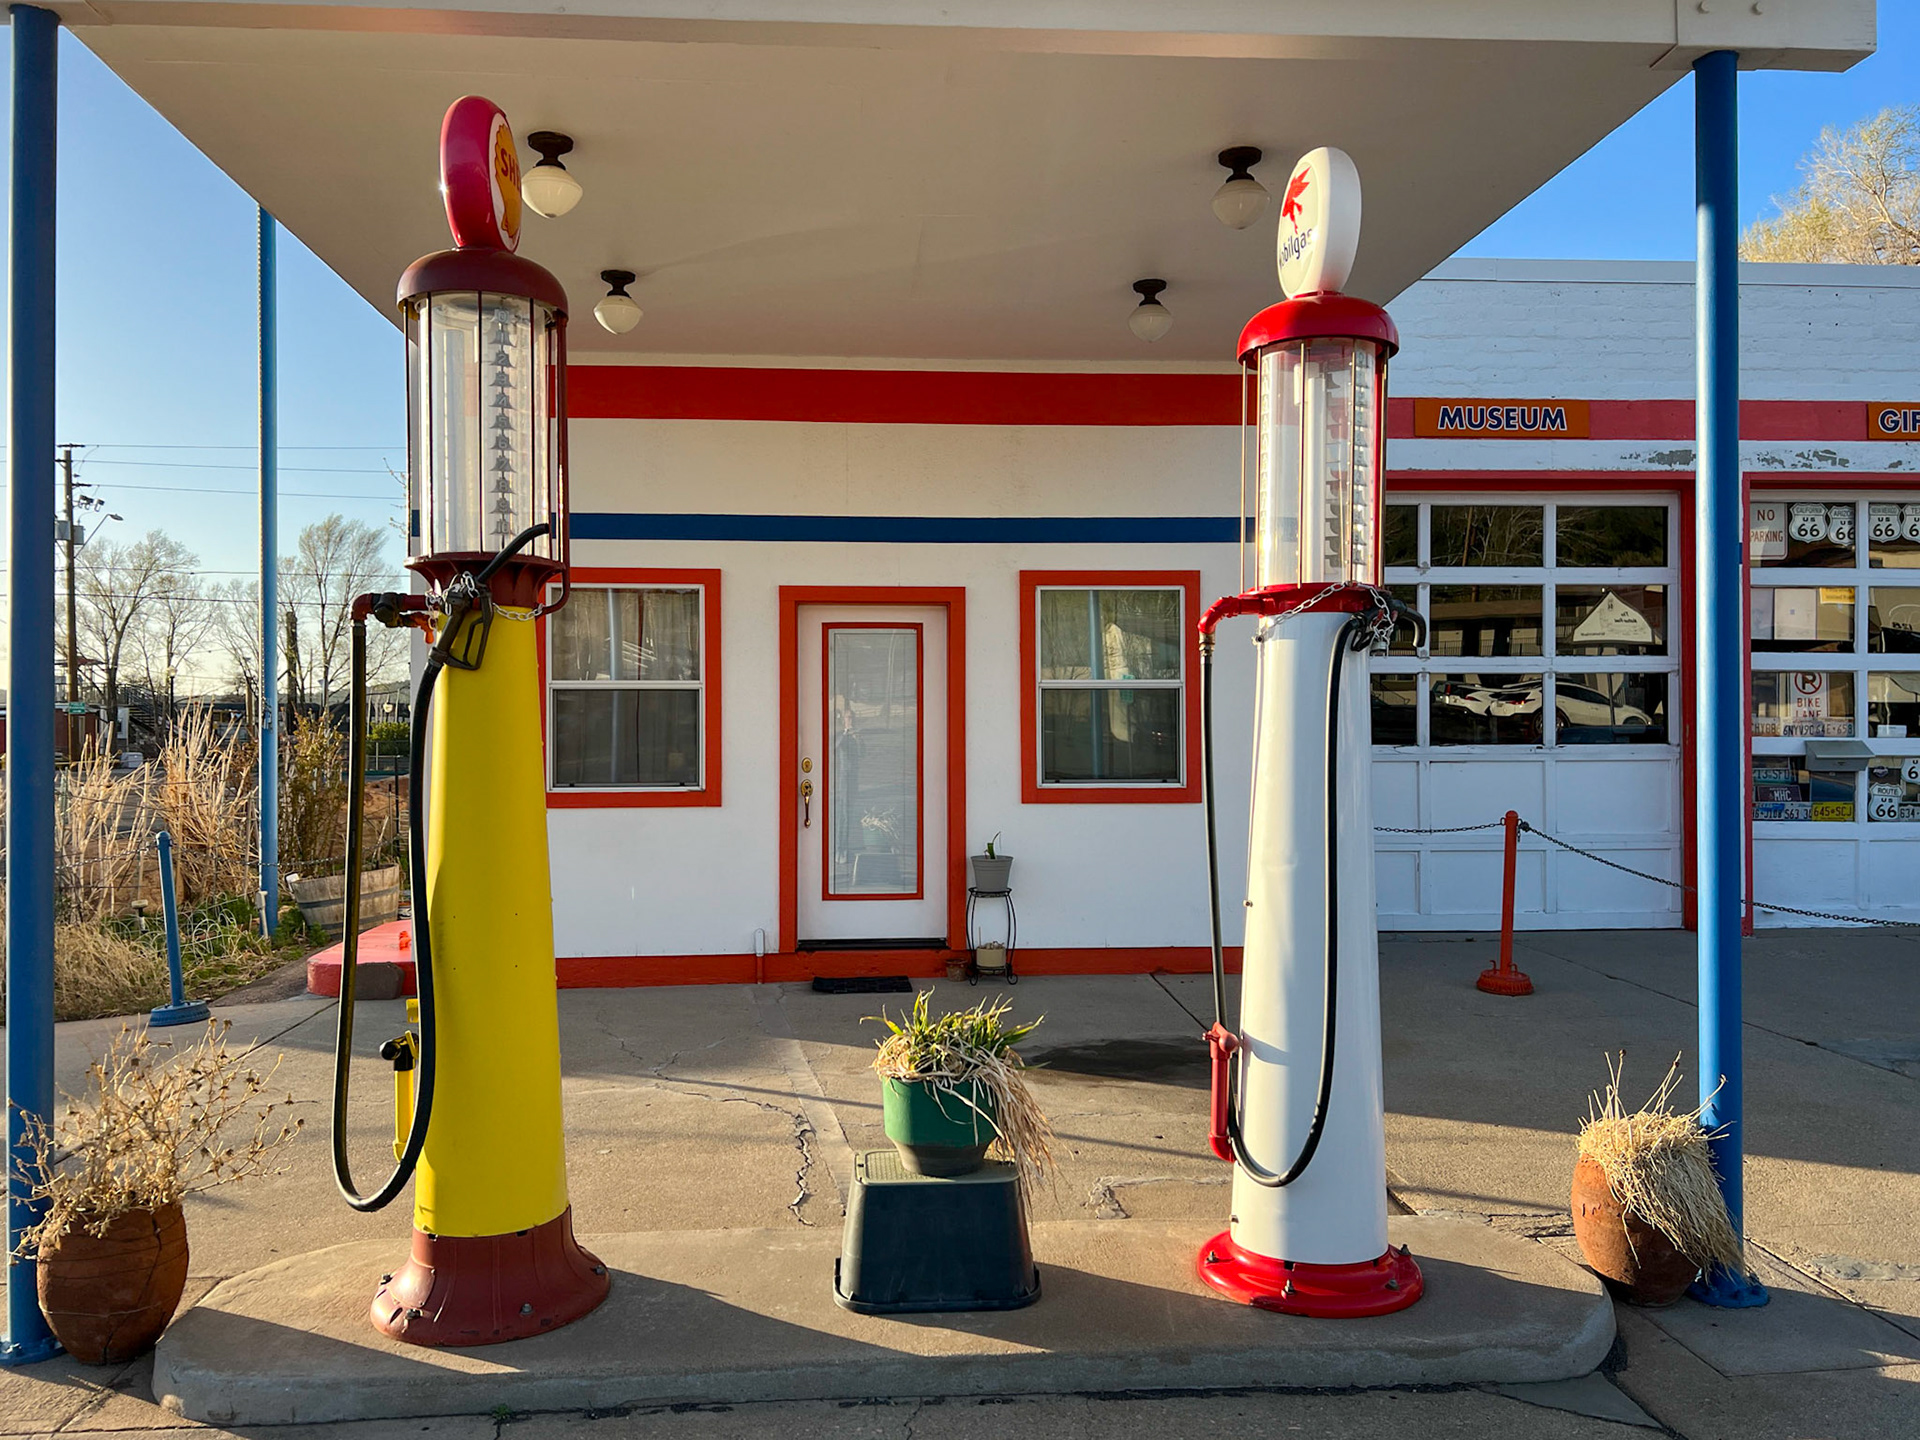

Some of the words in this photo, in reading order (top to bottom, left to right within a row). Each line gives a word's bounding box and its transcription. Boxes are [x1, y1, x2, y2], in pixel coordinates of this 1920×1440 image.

[1438, 405, 1568, 431] MUSEUM
[1757, 509, 1775, 521] NO
[1751, 531, 1783, 542] PARKING
[1798, 523, 1820, 537] 66
[1873, 523, 1895, 537] 66
[1797, 697, 1820, 707] BIKE
[1876, 804, 1897, 818] 66
